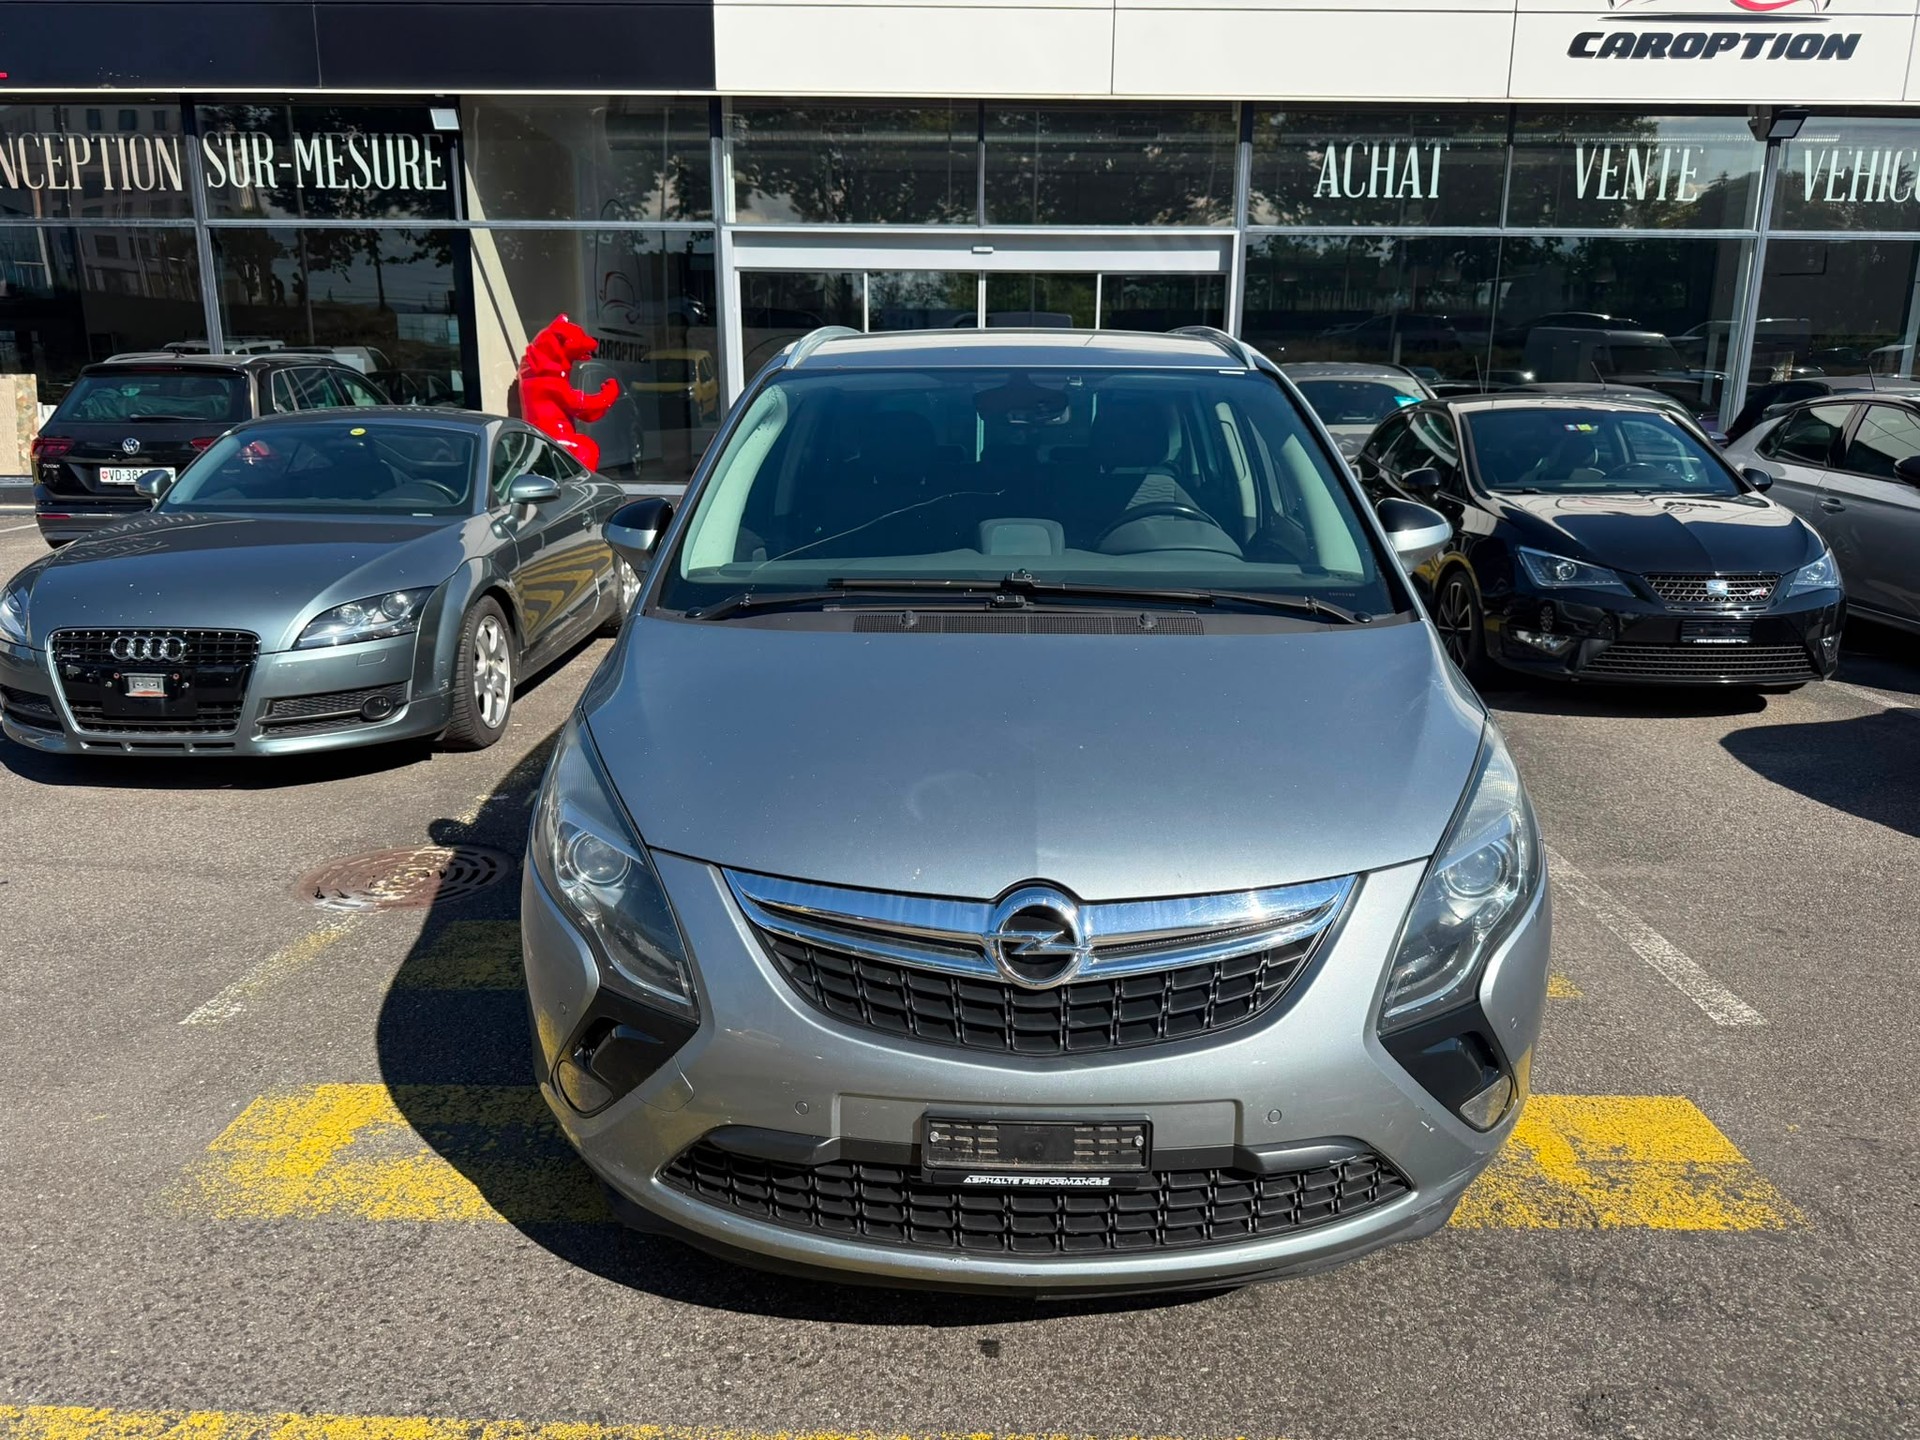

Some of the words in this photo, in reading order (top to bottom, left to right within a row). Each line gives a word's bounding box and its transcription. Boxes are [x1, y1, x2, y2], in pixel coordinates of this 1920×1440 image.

[1567, 32, 1862, 60] CAROPTION
[203, 131, 447, 191] SUR-MESURE
[1313, 140, 1450, 199] ACHAT
[1574, 144, 1704, 202] VENTE
[963, 1175, 1020, 1185] ASPHALTE
[1021, 1177, 1111, 1186] PERFORMANCES
